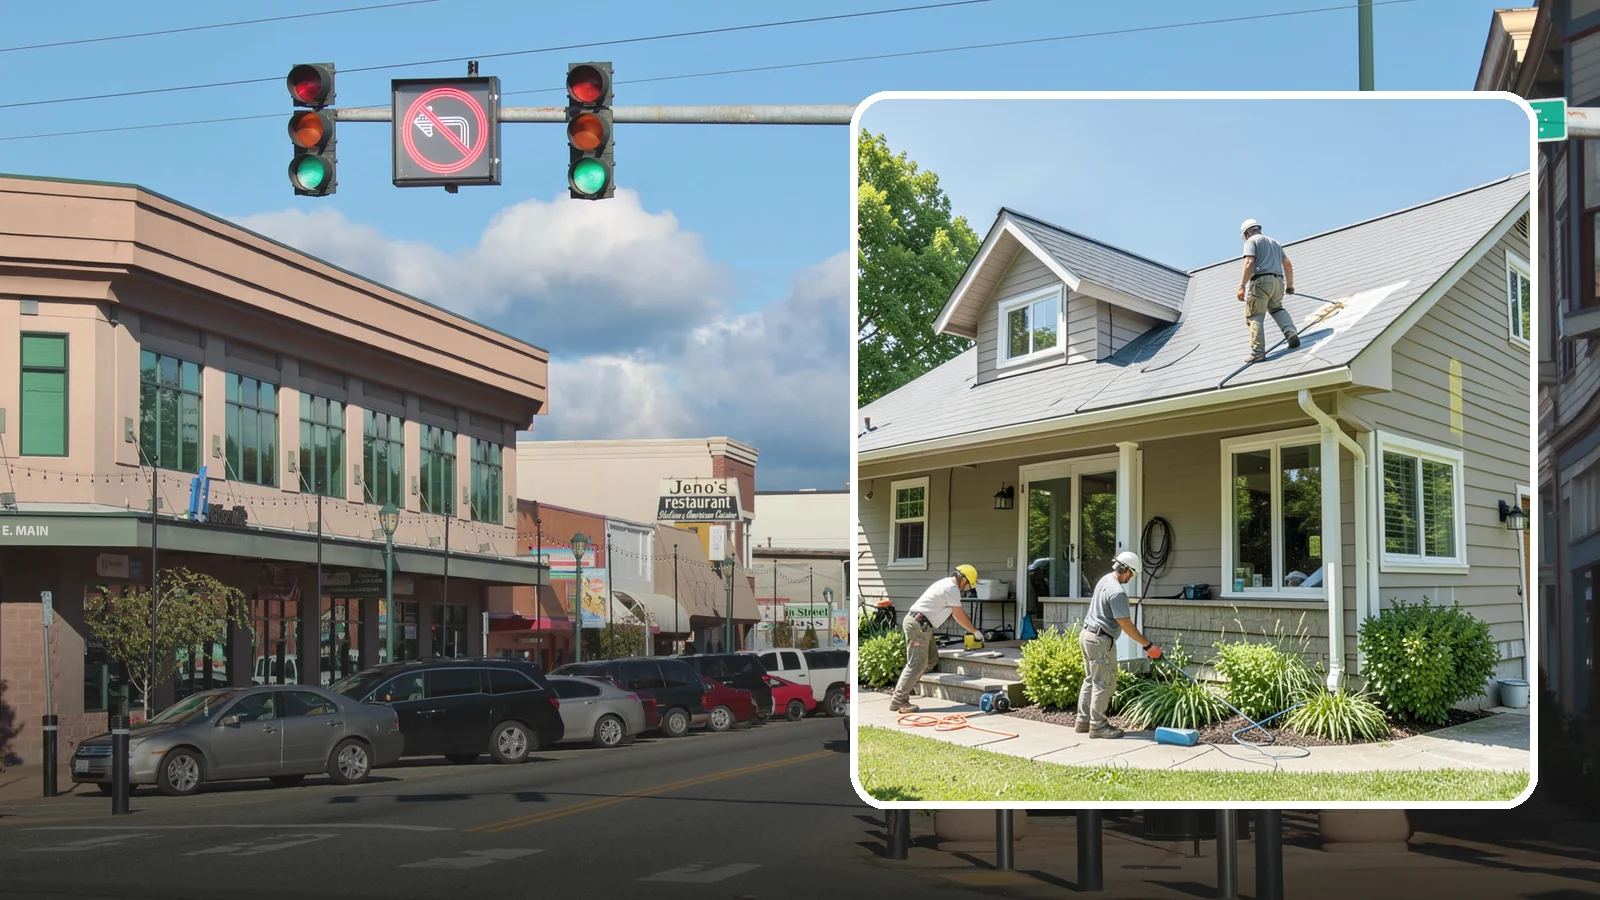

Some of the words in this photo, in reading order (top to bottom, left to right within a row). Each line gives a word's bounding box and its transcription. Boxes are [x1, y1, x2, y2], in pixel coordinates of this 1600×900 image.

[669, 480, 727, 494] Jeno's
[665, 496, 731, 509] restaurant
[659, 510, 681, 519] Italian
[686, 509, 714, 519] American
[715, 509, 738, 519] Cuisine
[2, 525, 13, 536] E.
[15, 525, 49, 536] MAIN
[797, 608, 828, 617] Street
[790, 619, 823, 627] lass
